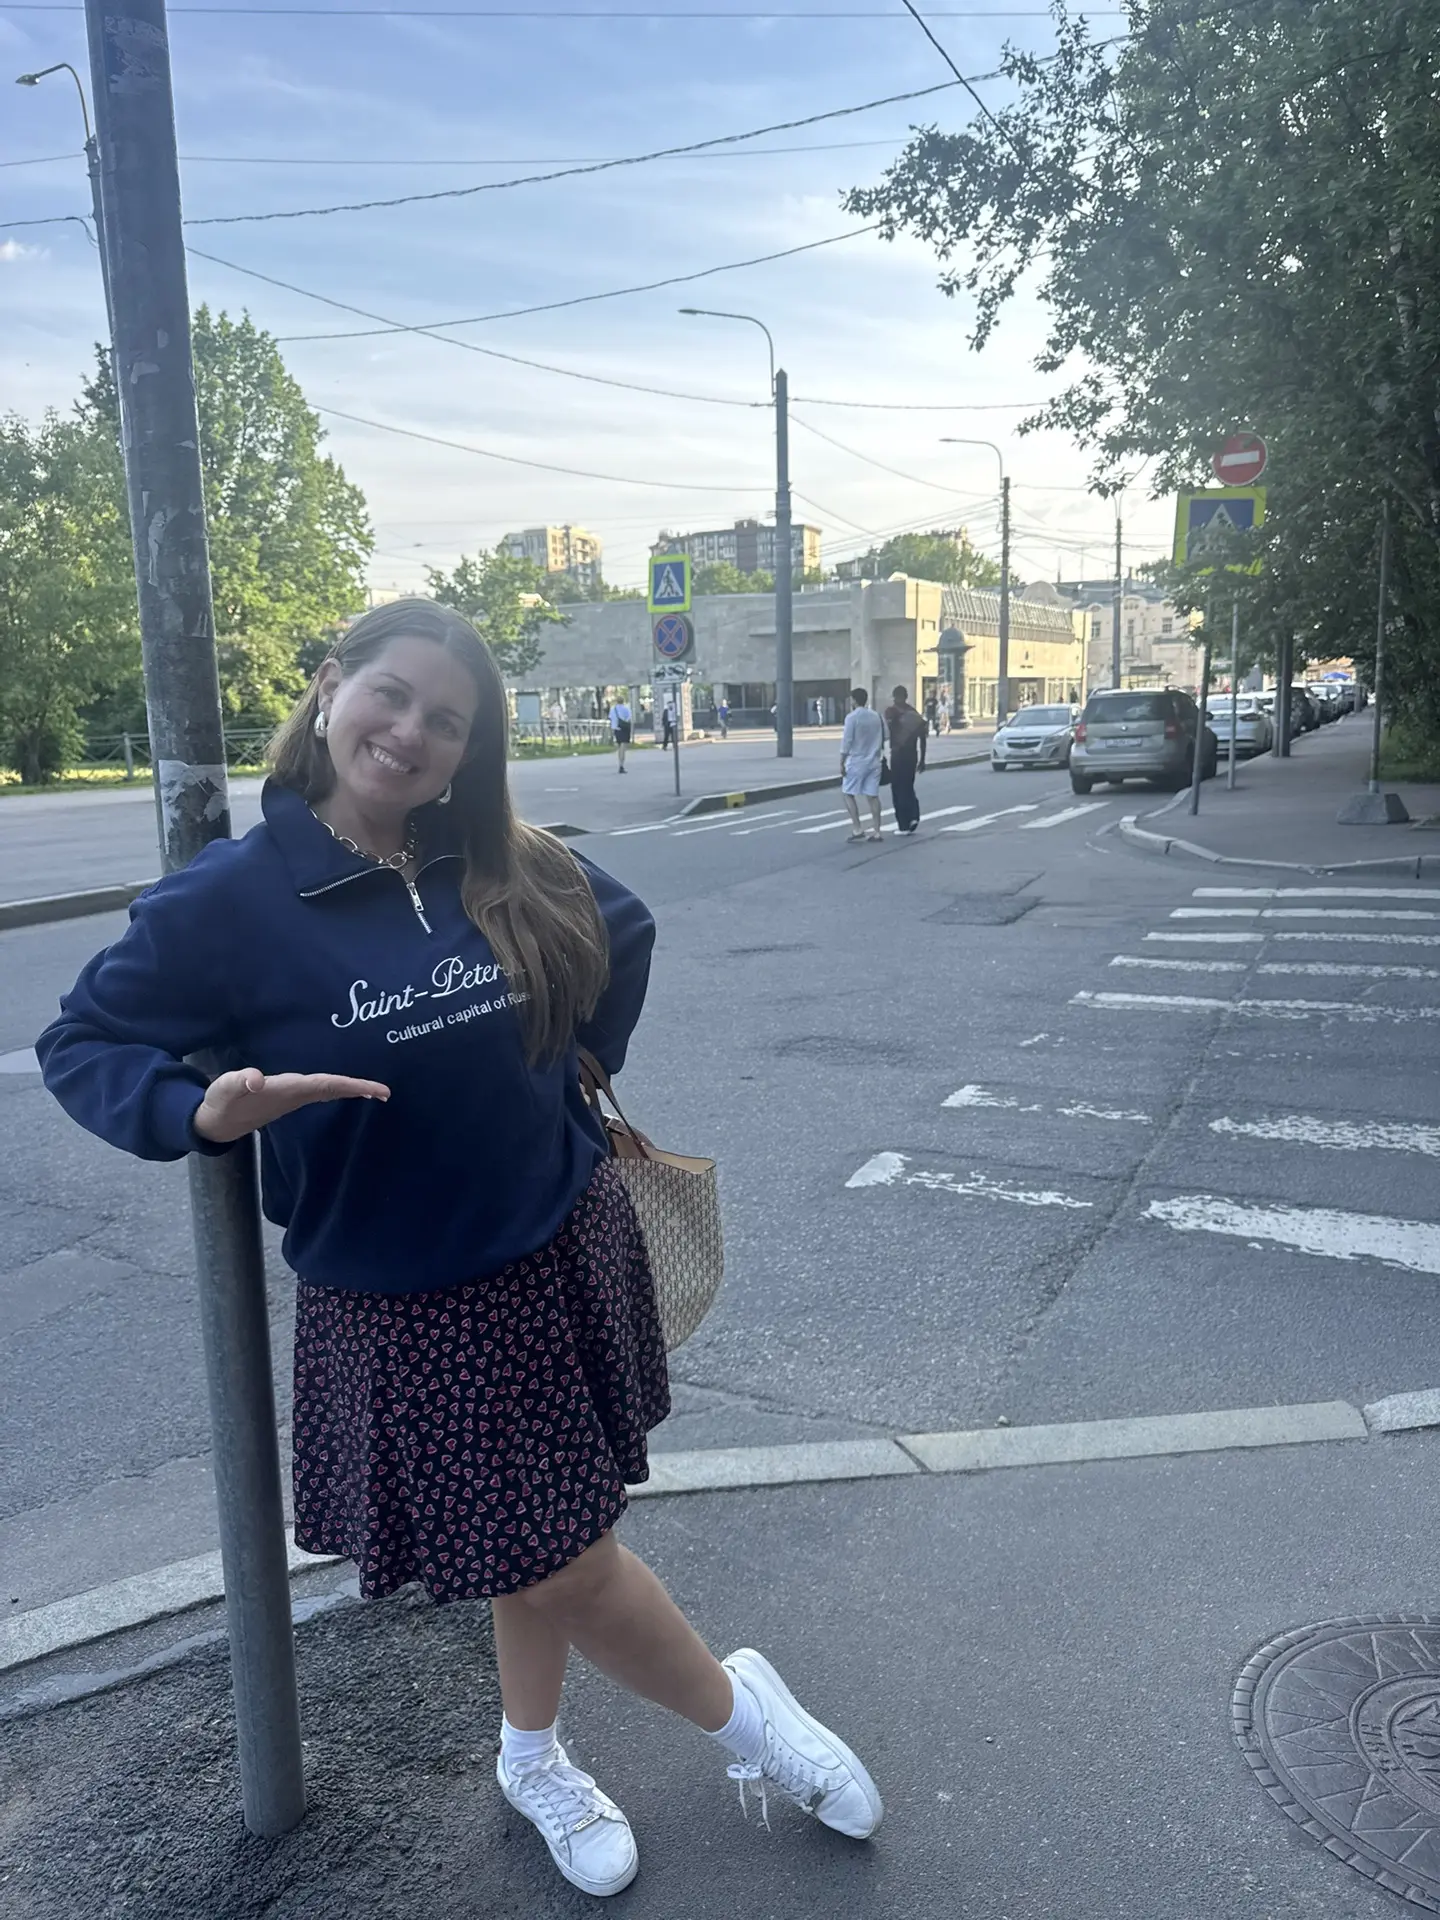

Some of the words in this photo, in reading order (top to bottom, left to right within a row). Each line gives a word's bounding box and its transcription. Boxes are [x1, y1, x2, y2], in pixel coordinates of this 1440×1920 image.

[386, 1016, 444, 1044] Cultural
[447, 1000, 493, 1023] capital
[493, 994, 507, 1010] of
